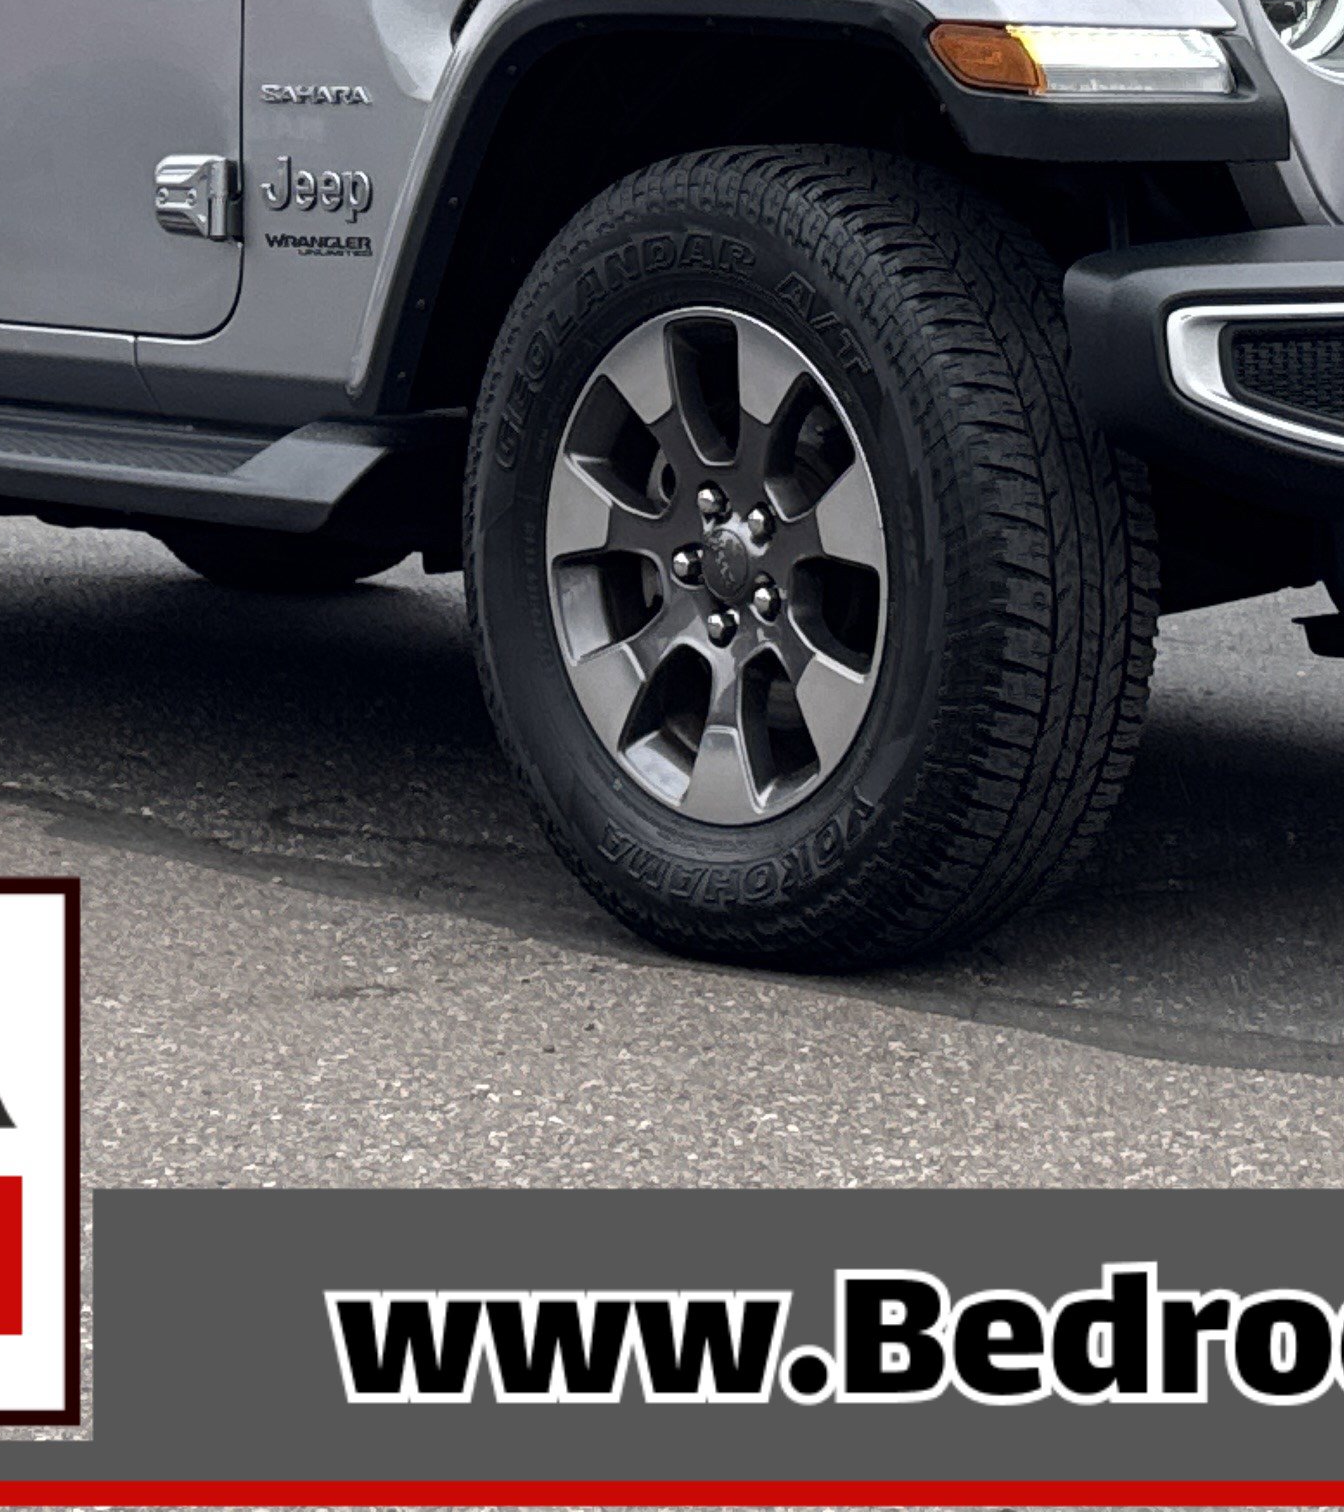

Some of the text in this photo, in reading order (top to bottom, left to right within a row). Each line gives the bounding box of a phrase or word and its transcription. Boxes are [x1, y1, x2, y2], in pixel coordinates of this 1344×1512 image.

[260, 83, 373, 106] SAHARA
[260, 155, 374, 224] Jeep
[264, 233, 372, 250] WRANGLER
[496, 226, 757, 472] GEOLANDAR
[774, 268, 873, 374] A/T
[596, 794, 878, 908] YOKOHAMA
